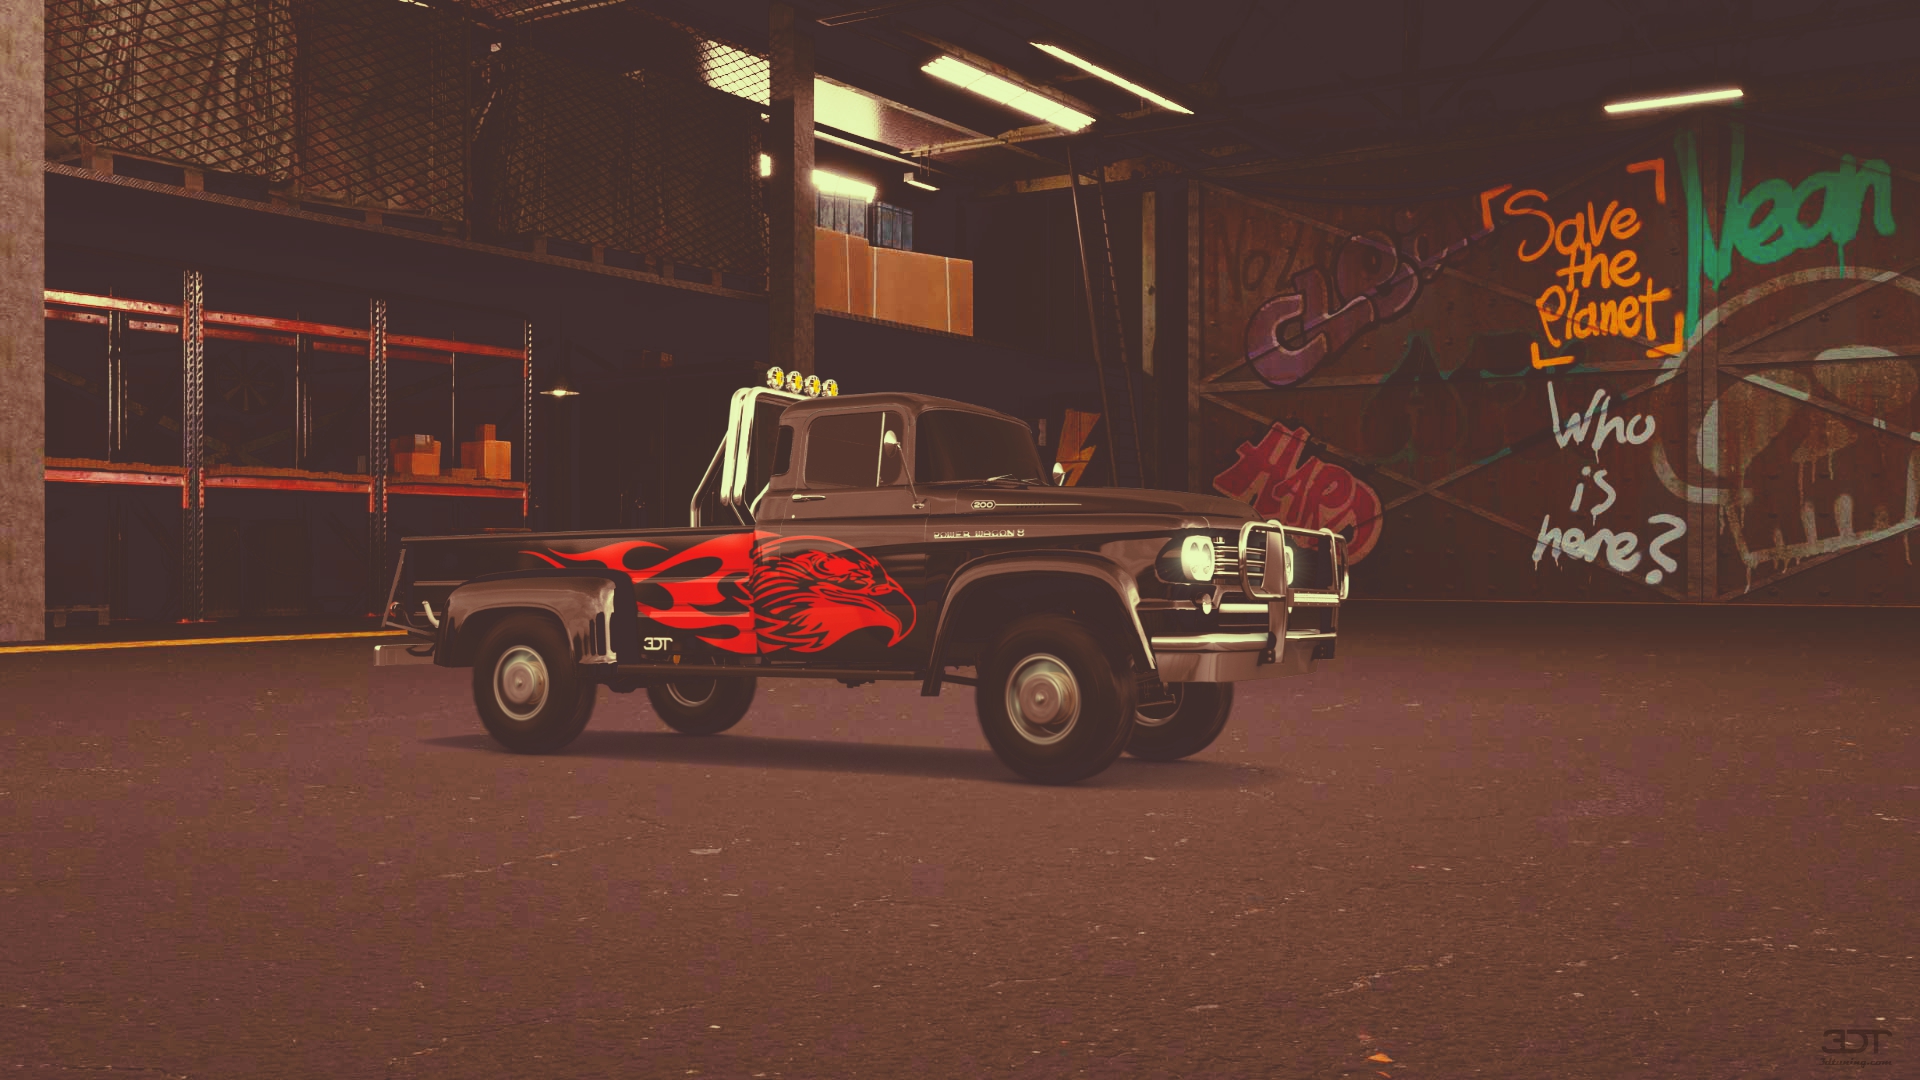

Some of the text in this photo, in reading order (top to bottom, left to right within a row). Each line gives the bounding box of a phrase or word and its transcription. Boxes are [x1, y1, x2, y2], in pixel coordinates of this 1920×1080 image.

[1504, 189, 1642, 262] Save
[1555, 242, 1641, 292] the
[1535, 278, 1673, 348] Planet
[1547, 381, 1656, 460] Who
[973, 501, 995, 509] 200
[1570, 466, 1617, 519] is
[1532, 514, 1687, 585] here?
[643, 636, 674, 651] 3DT
